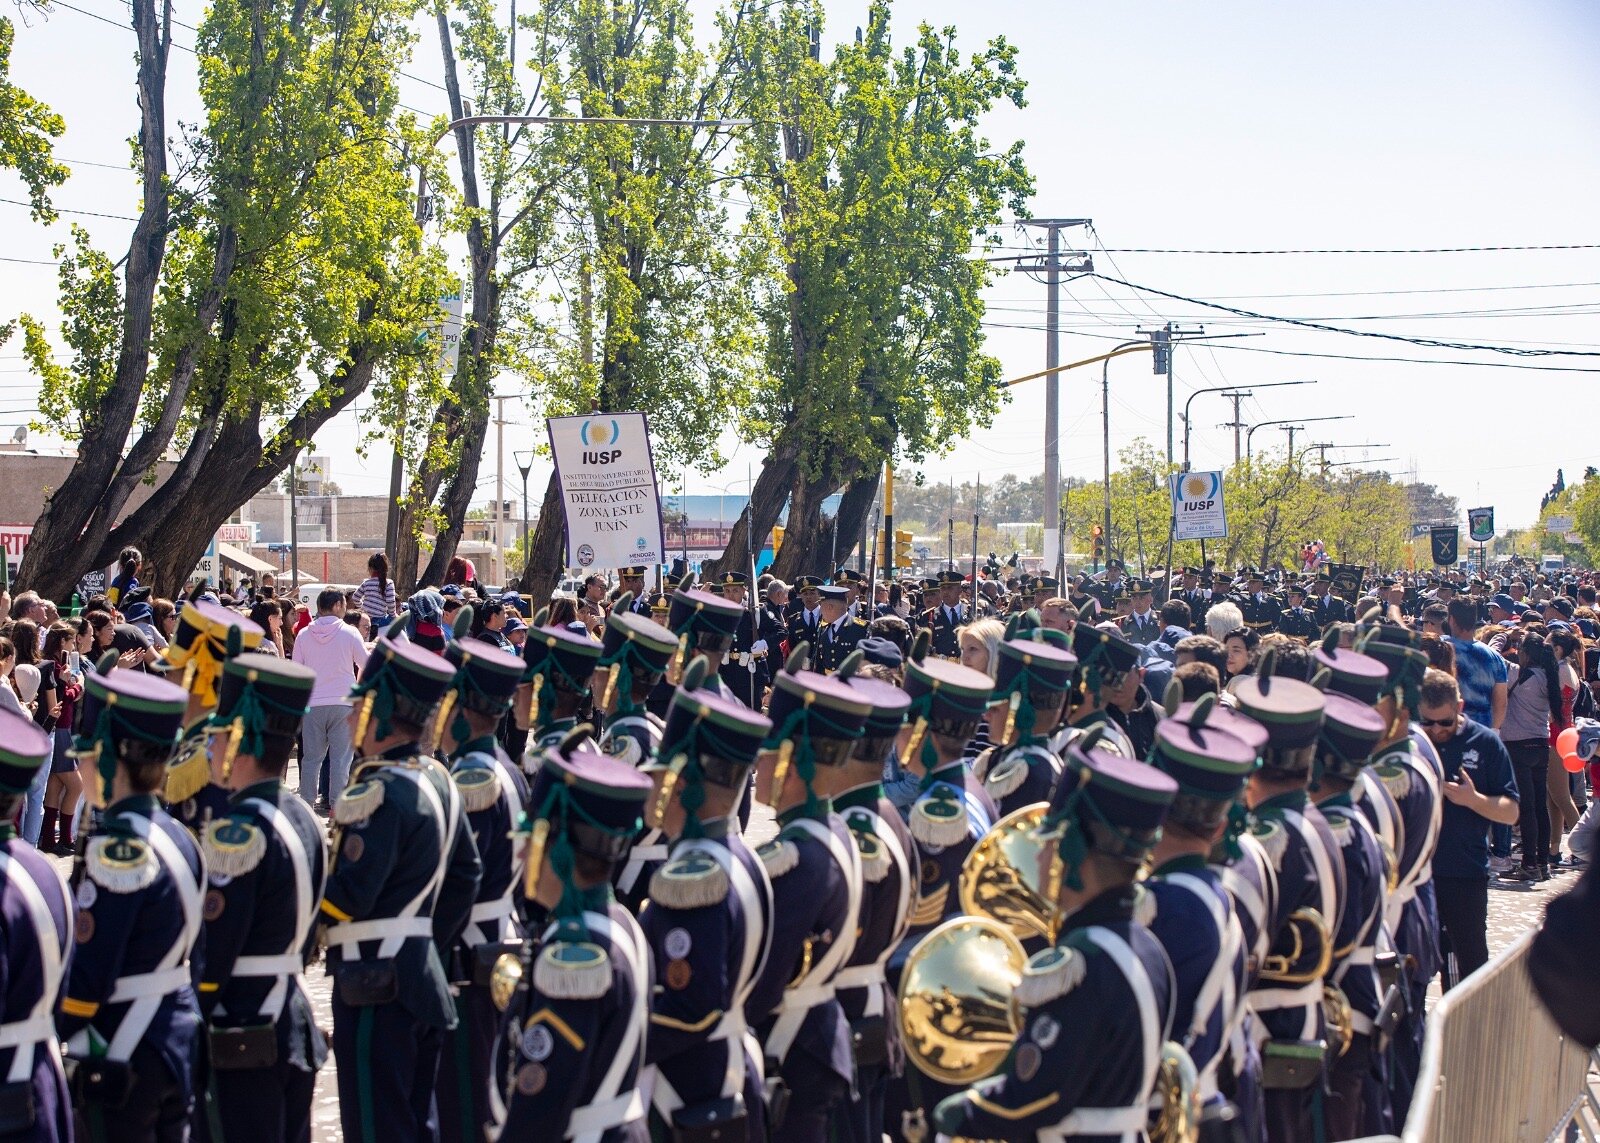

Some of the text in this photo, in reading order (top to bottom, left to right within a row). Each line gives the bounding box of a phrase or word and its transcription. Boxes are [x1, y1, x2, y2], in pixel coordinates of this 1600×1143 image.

[582, 449, 622, 465] IUSP
[598, 469, 650, 480] UNIVERSITARIO
[571, 487, 648, 504] DELEGACIÓN
[578, 503, 644, 518] ZONA ESTE
[1183, 500, 1215, 512] IUSP
[593, 519, 629, 532] JUNÍN
